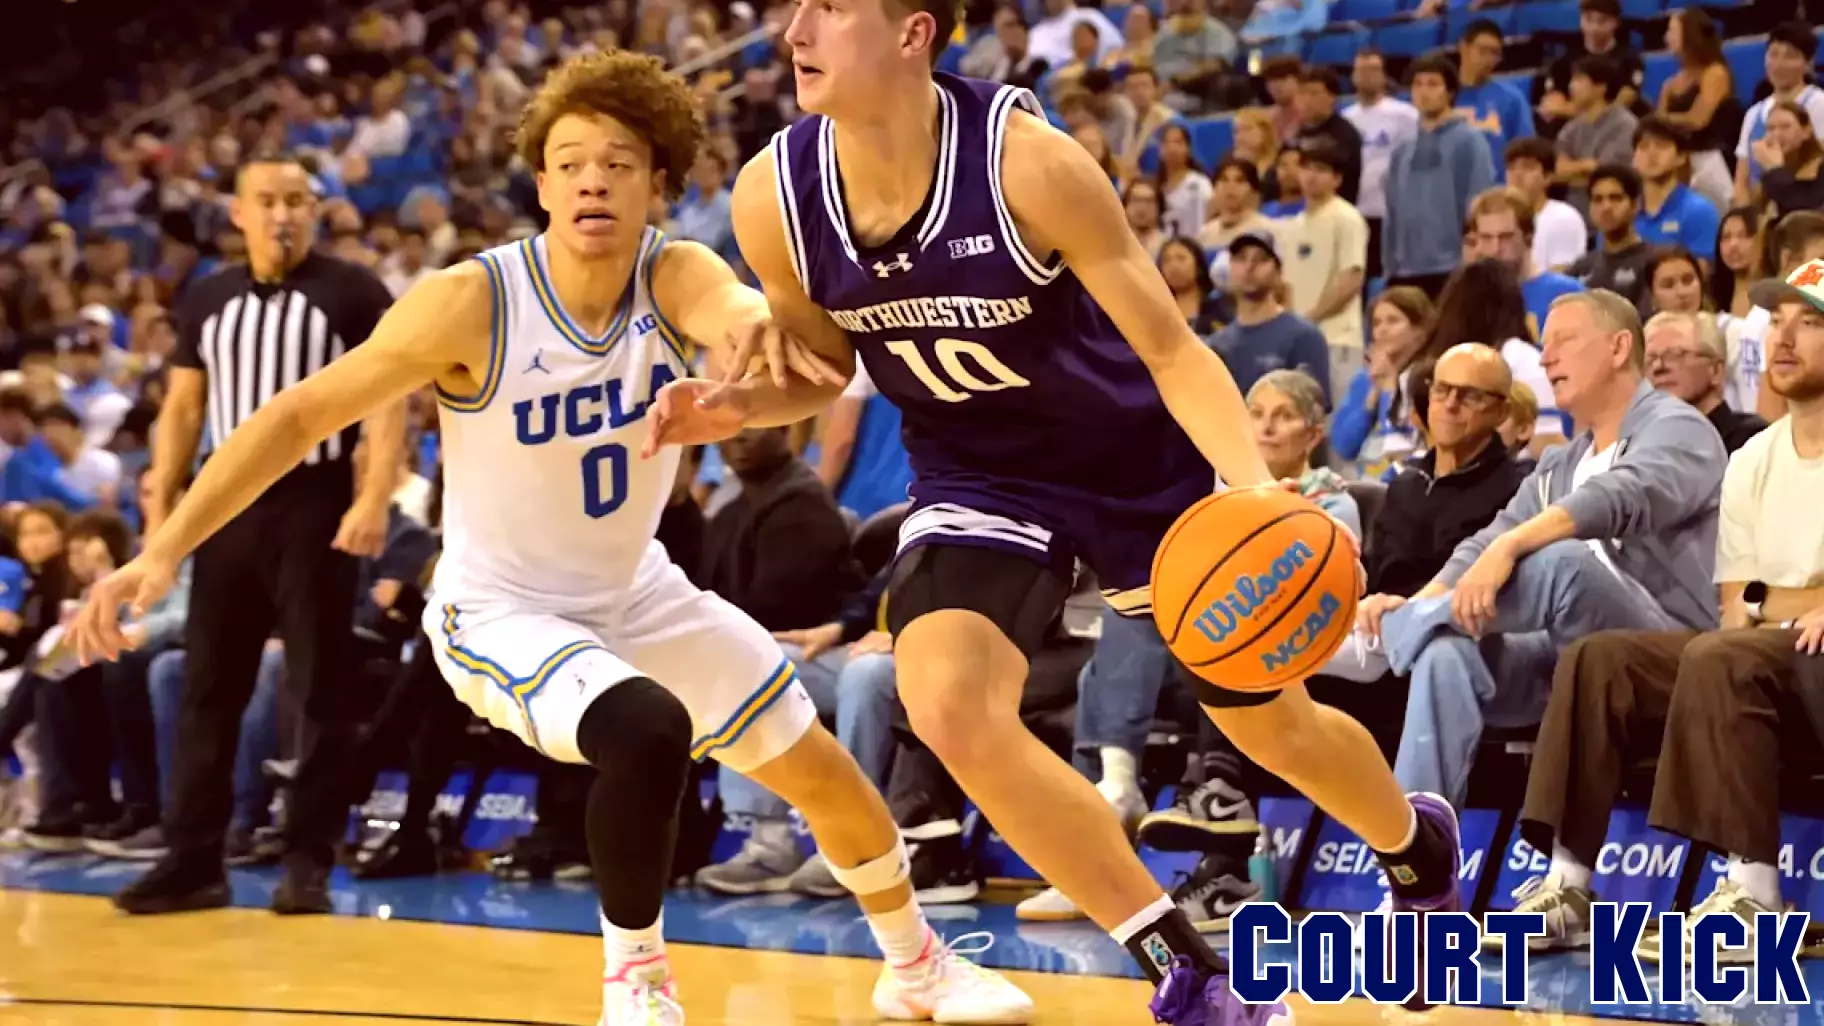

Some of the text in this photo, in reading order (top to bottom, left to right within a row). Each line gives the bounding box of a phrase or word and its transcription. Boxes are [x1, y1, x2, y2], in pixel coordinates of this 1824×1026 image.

[884, 338, 1031, 403] 10
[582, 443, 628, 519] 0
[1193, 539, 1315, 644] Wilson
[1260, 591, 1342, 673] NCAA
